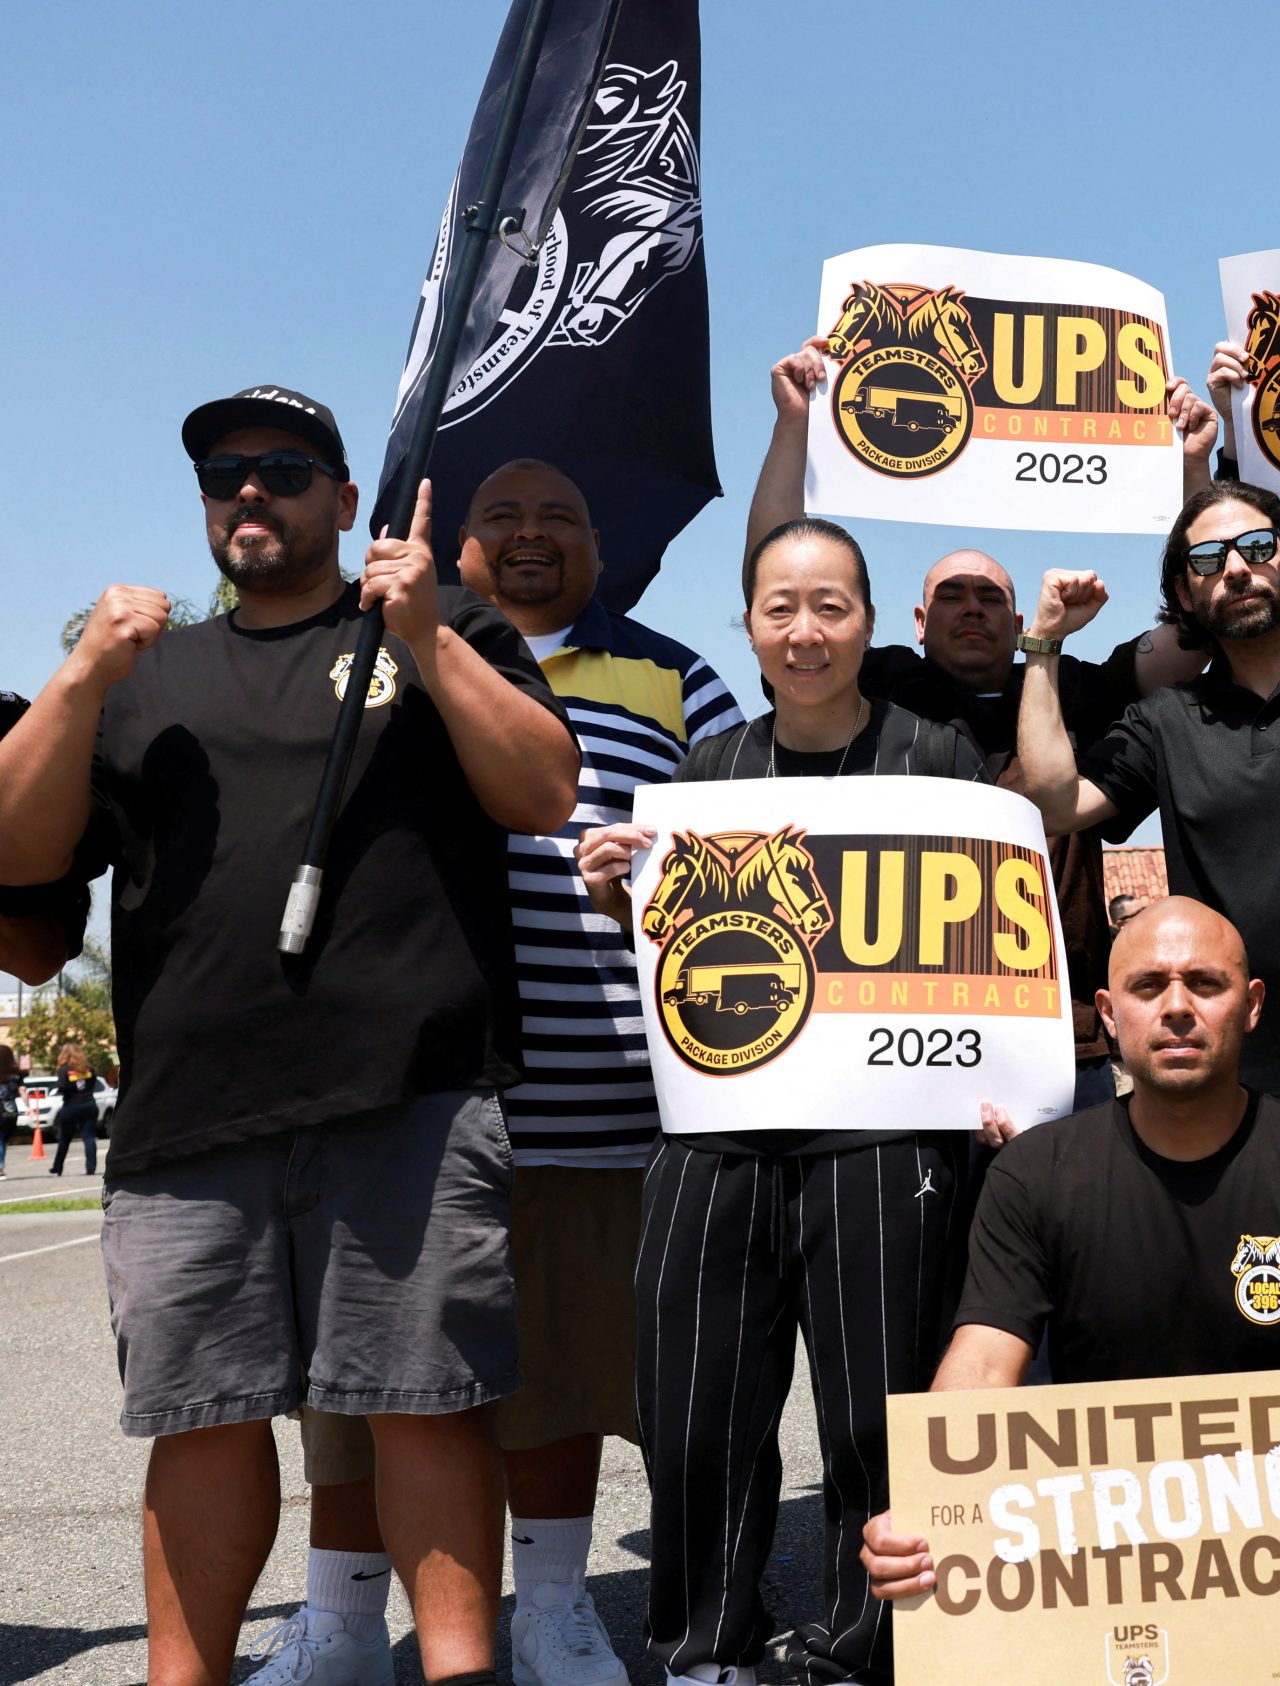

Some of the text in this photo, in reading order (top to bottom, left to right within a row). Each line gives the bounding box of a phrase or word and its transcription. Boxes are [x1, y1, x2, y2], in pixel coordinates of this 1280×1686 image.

[528, 299, 544, 321] of
[450, 323, 534, 397] Teamste
[852, 350, 956, 389] TEAMSTERS
[993, 312, 1167, 409] UPS
[984, 413, 1169, 440] CONTRACT
[857, 440, 948, 470] PACKAGE DIVISION
[1015, 452, 1108, 485] 2023
[840, 850, 1050, 970] UPS
[672, 914, 794, 958] TEAMSTERS
[828, 980, 1057, 1010] CONTRACT
[681, 1030, 783, 1064] PACKAGE DIVISION
[867, 1028, 982, 1068] 2023
[1250, 1282, 1280, 1294] LOCAL
[1253, 1295, 1278, 1310] 396
[931, 1504, 967, 1526] FOR
[972, 1504, 982, 1524] A
[1114, 1624, 1158, 1642] UPS
[1116, 1642, 1158, 1650] TEAMSTERS
